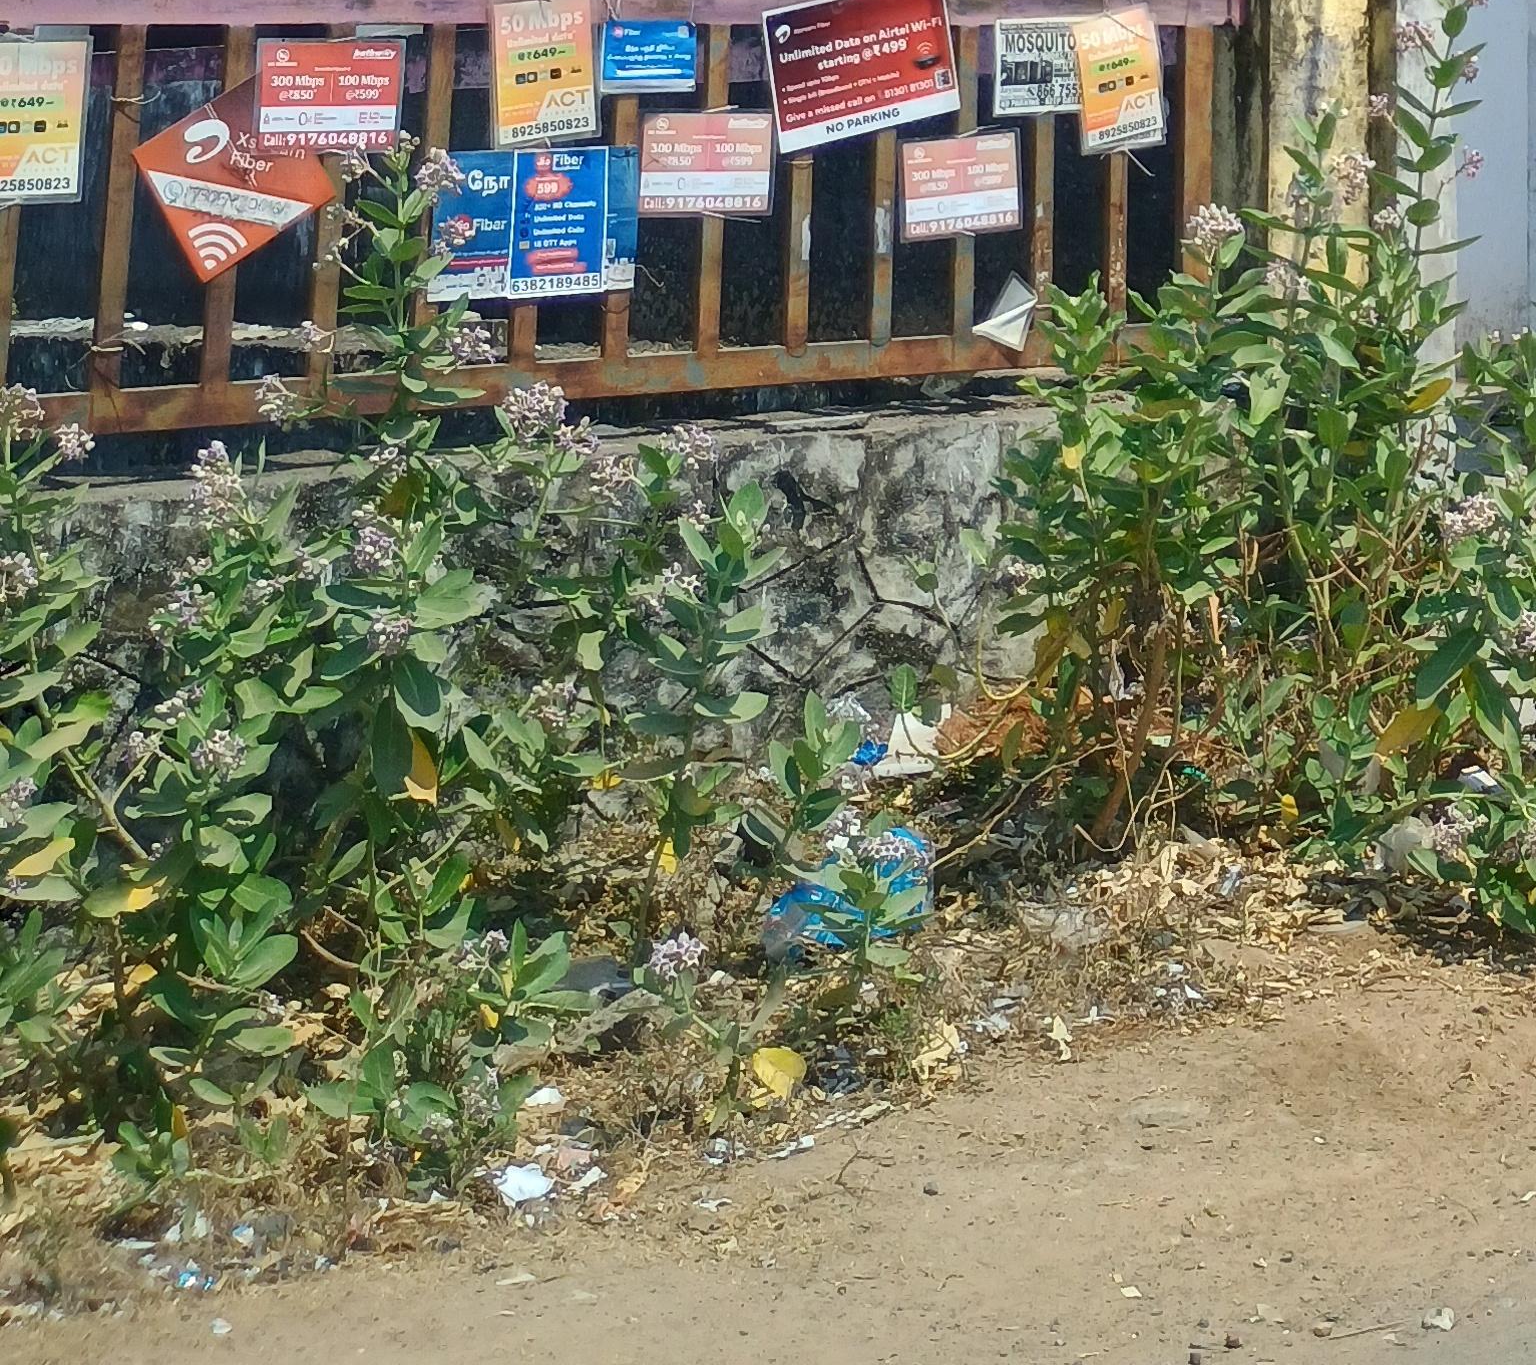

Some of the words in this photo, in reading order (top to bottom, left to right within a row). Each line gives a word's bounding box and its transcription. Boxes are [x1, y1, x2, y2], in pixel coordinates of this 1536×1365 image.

[500, 14, 524, 35] 50
[529, 9, 583, 31] Mbps
[779, 42, 833, 64] Unlimited
[834, 36, 861, 50] Data
[863, 33, 877, 43] on
[878, 24, 910, 40] Airtel
[910, 16, 942, 33] Wi-Fi
[1006, 32, 1077, 53] MOSQUITO
[817, 52, 861, 71] starting
[271, 75, 293, 86] 300
[295, 75, 324, 88] Mbps
[339, 75, 359, 86] 100
[361, 75, 389, 87] Mbps
[546, 88, 591, 108] ACT
[1125, 92, 1156, 111] ACT
[786, 112, 806, 123] Give
[847, 97, 863, 108] call
[864, 95, 876, 103] on
[511, 117, 589, 138] 8925850823
[826, 122, 844, 134] NO
[847, 107, 901, 129] PARKING
[26, 146, 74, 164] ACT
[650, 143, 672, 153] 300
[674, 143, 702, 154] Mbps
[715, 143, 734, 153] 100
[553, 154, 584, 165] Fiber
[473, 218, 508, 232] Fiber
[512, 275, 599, 292] 6382189485
